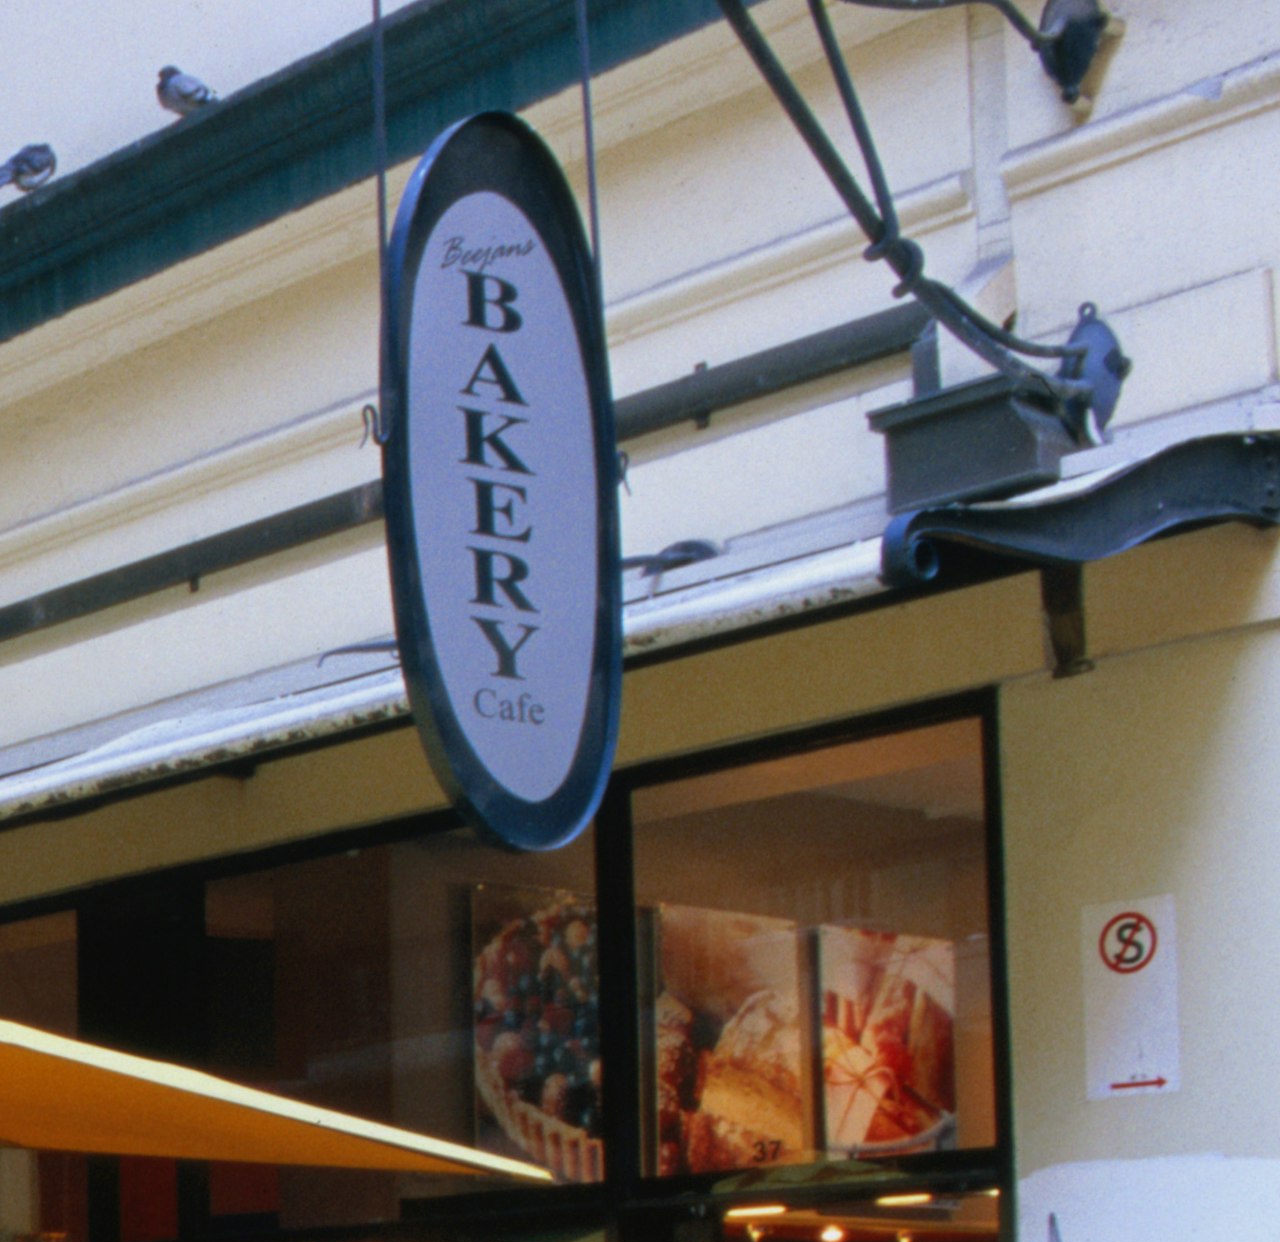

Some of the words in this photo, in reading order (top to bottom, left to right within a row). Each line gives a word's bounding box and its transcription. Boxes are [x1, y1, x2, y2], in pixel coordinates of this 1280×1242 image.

[457, 268, 539, 681] BAKERY
[473, 687, 545, 726] Cafe
[753, 1139, 782, 1162] 37
